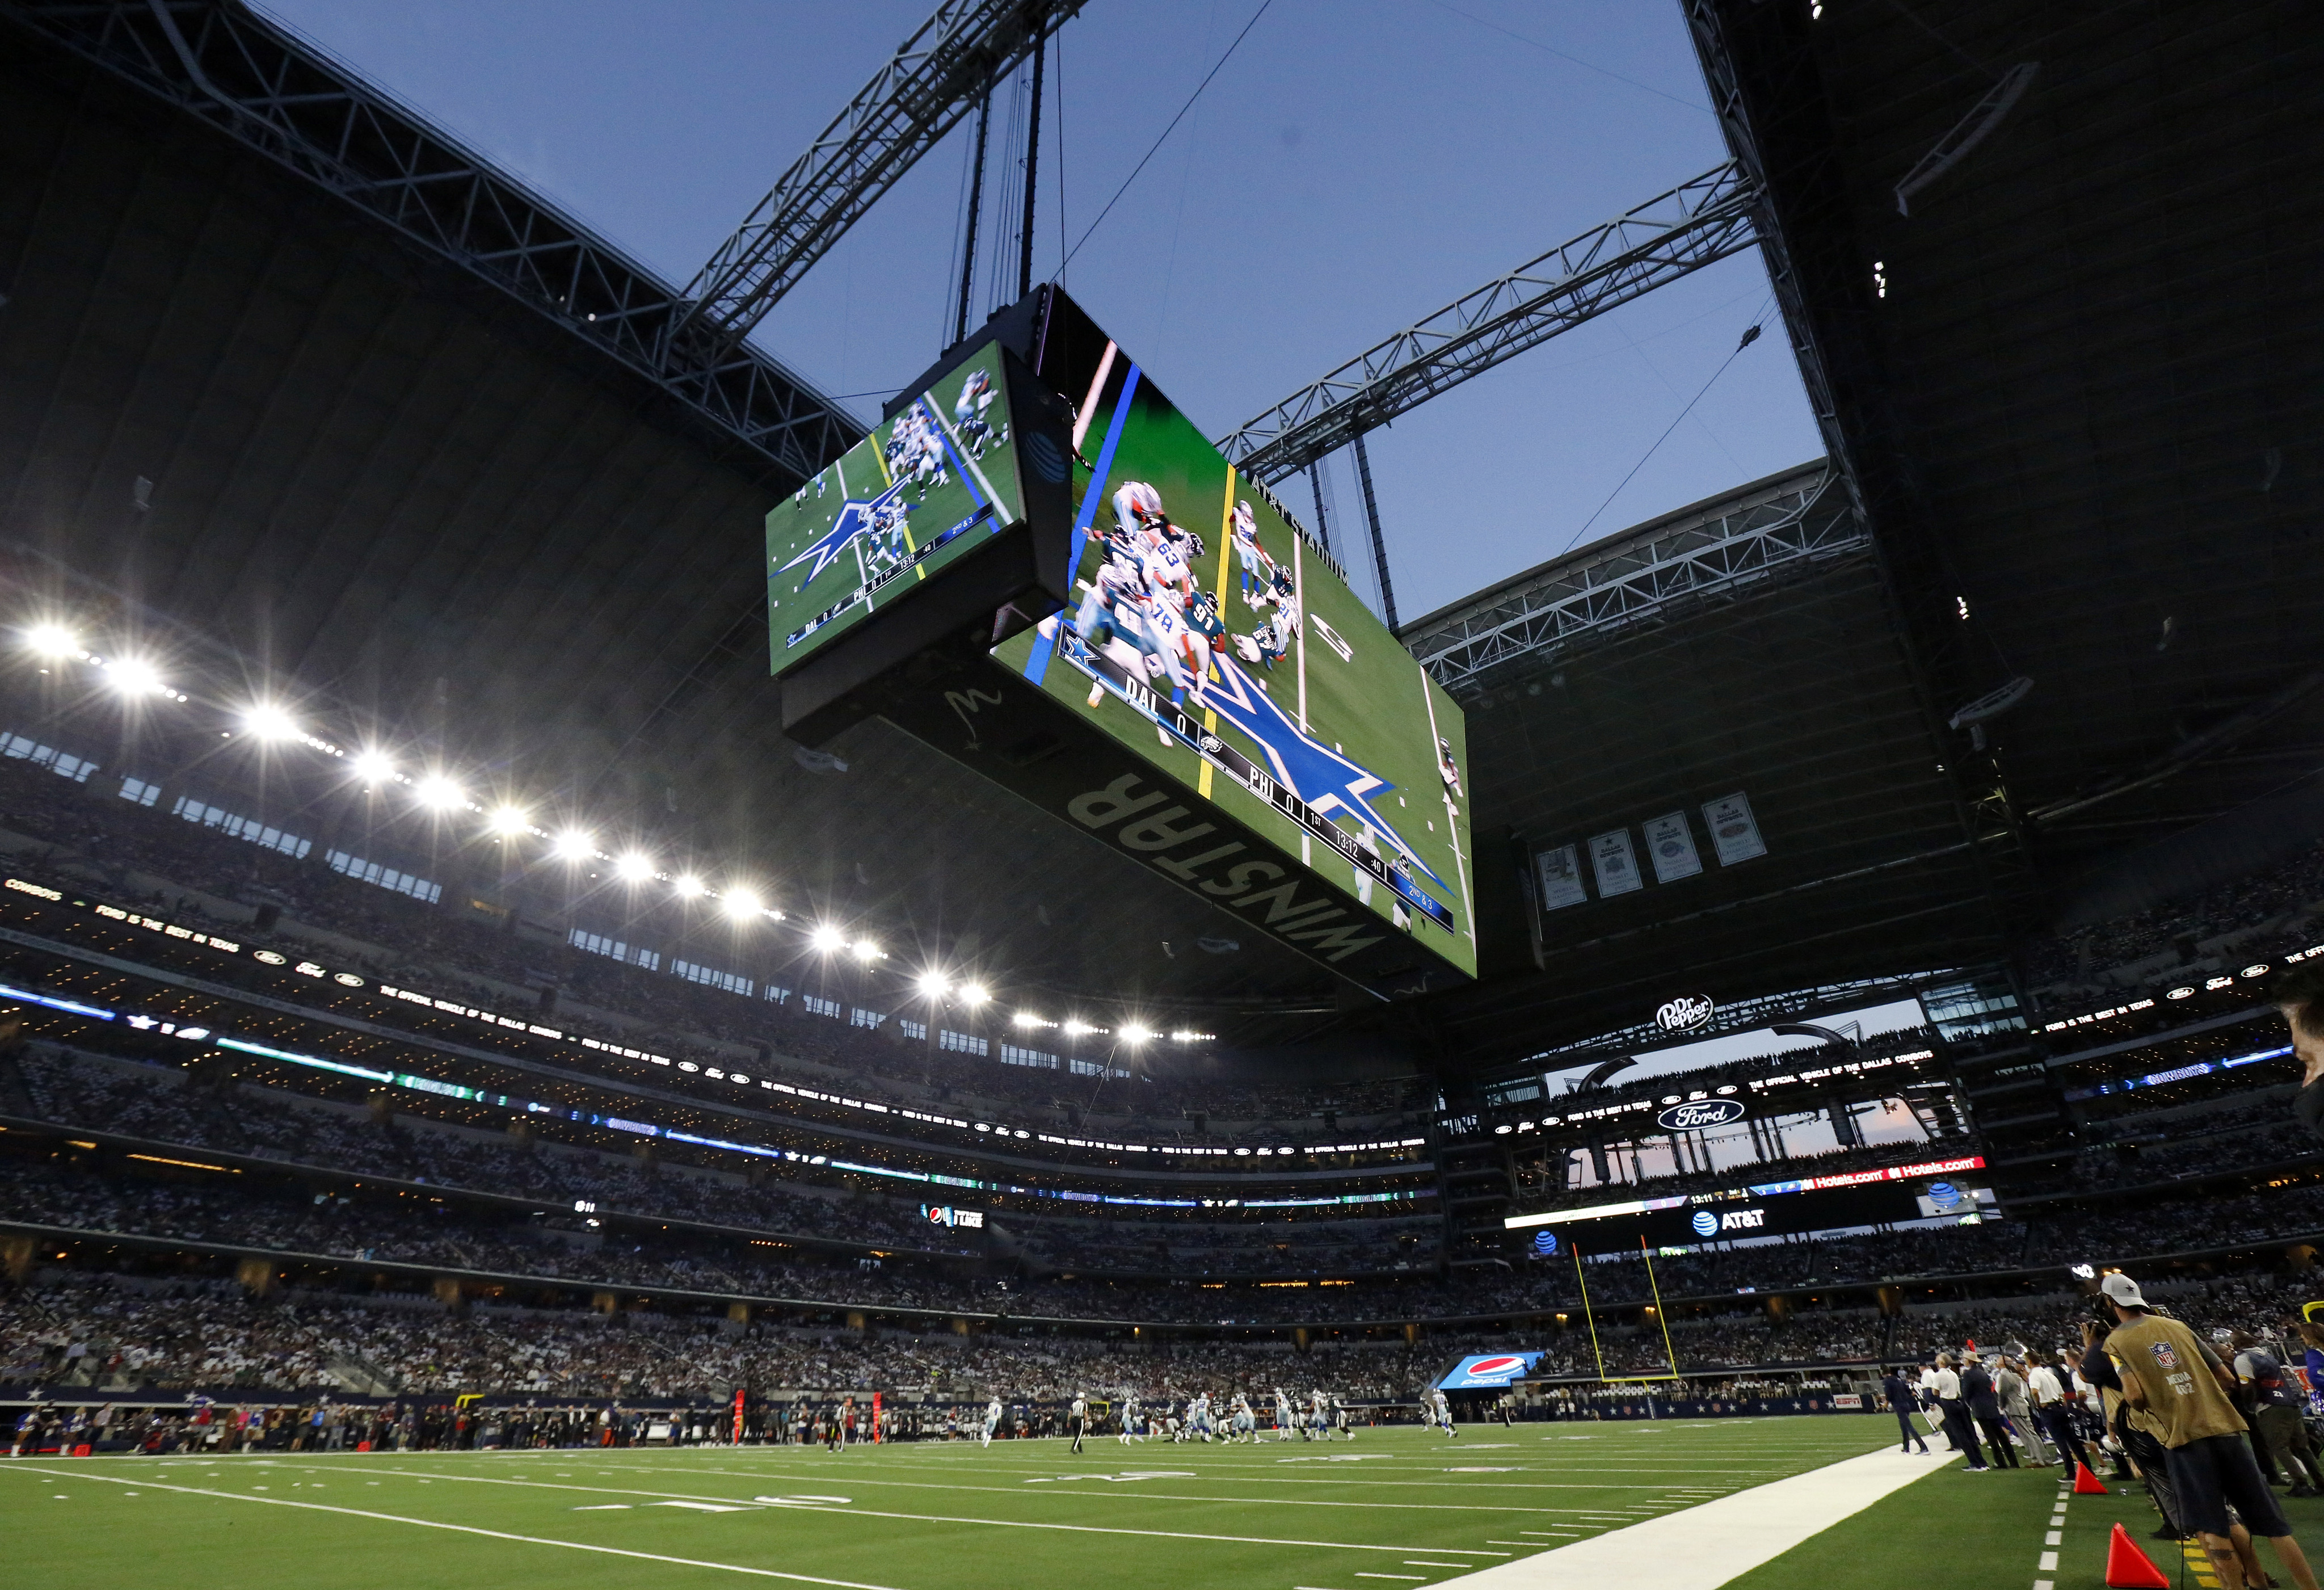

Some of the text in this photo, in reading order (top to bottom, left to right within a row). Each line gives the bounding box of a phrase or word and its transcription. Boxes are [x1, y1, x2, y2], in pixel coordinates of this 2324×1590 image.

[1252, 474, 1349, 587] AT&T STADIUM
[900, 554, 915, 569] 13:12
[952, 523, 962, 535] 2ND
[1158, 543, 1180, 567] 63
[853, 580, 876, 601] PHI 0
[1154, 603, 1173, 633] 78
[1193, 603, 1214, 630] 91
[1278, 603, 1290, 620] 21
[805, 612, 827, 633] DAL 0
[1125, 675, 1186, 735] DAL 0
[1250, 765, 1294, 813] PHI 0
[1067, 772, 1386, 962] WINSTAR
[1311, 813, 1433, 910] 1ST 13:12 :40 2ND & 3
[5, 879, 62, 901] COWBOYS
[95, 905, 240, 953] FORD IS THE BEST IN TEXAS
[2284, 952, 2305, 963] THE
[296, 962, 326, 978] Ford
[2206, 977, 2234, 991] Ford
[380, 985, 562, 1040] THE OFFICIAL VEHICLE OF THE DALLAS COWBOYS
[1657, 1001, 1708, 1030] Pepper
[1673, 998, 1694, 1015] Dr
[2045, 1021, 2066, 1032] FORD
[2077, 1014, 2094, 1024] THE
[2095, 1009, 2116, 1020] BEST
[2117, 1006, 2128, 1015] IN
[2128, 999, 2155, 1011] TEXAS
[582, 1038, 600, 1049] FORD
[609, 1045, 623, 1055] THE
[624, 1049, 641, 1059] BEST
[651, 1055, 671, 1066] TEXAS
[1749, 1050, 1934, 1089] THE OFFICIAL VEHICLE OF THE DALLAS COWBOYS
[2150, 1063, 2205, 1084] COWBOYS
[761, 1080, 773, 1089] THE
[797, 1088, 819, 1100] VEHICLE
[842, 1098, 862, 1108] DALLAS
[902, 1110, 915, 1118] FORD
[933, 1116, 945, 1125] BEST
[1568, 1112, 1584, 1121] FORD
[1606, 1105, 1622, 1114] BEST
[1631, 1100, 1652, 1110] TEXAS
[1675, 1103, 1728, 1127] Ford
[1902, 1159, 1974, 1176] Hotels.com
[941, 1176, 965, 1187] EAGLES
[1816, 1170, 1882, 1188] Hotels.com
[1066, 1192, 1095, 1202] COWBOYS
[1691, 1193, 1713, 1204] 13:11
[953, 1215, 958, 1225] I
[959, 1215, 983, 1228] LIKE
[1721, 1209, 1765, 1230] AT&T
[2157, 1352, 2176, 1366] NFL
[1460, 1377, 1508, 1386] pepsi
[2166, 1372, 2192, 1386] MEDIA
